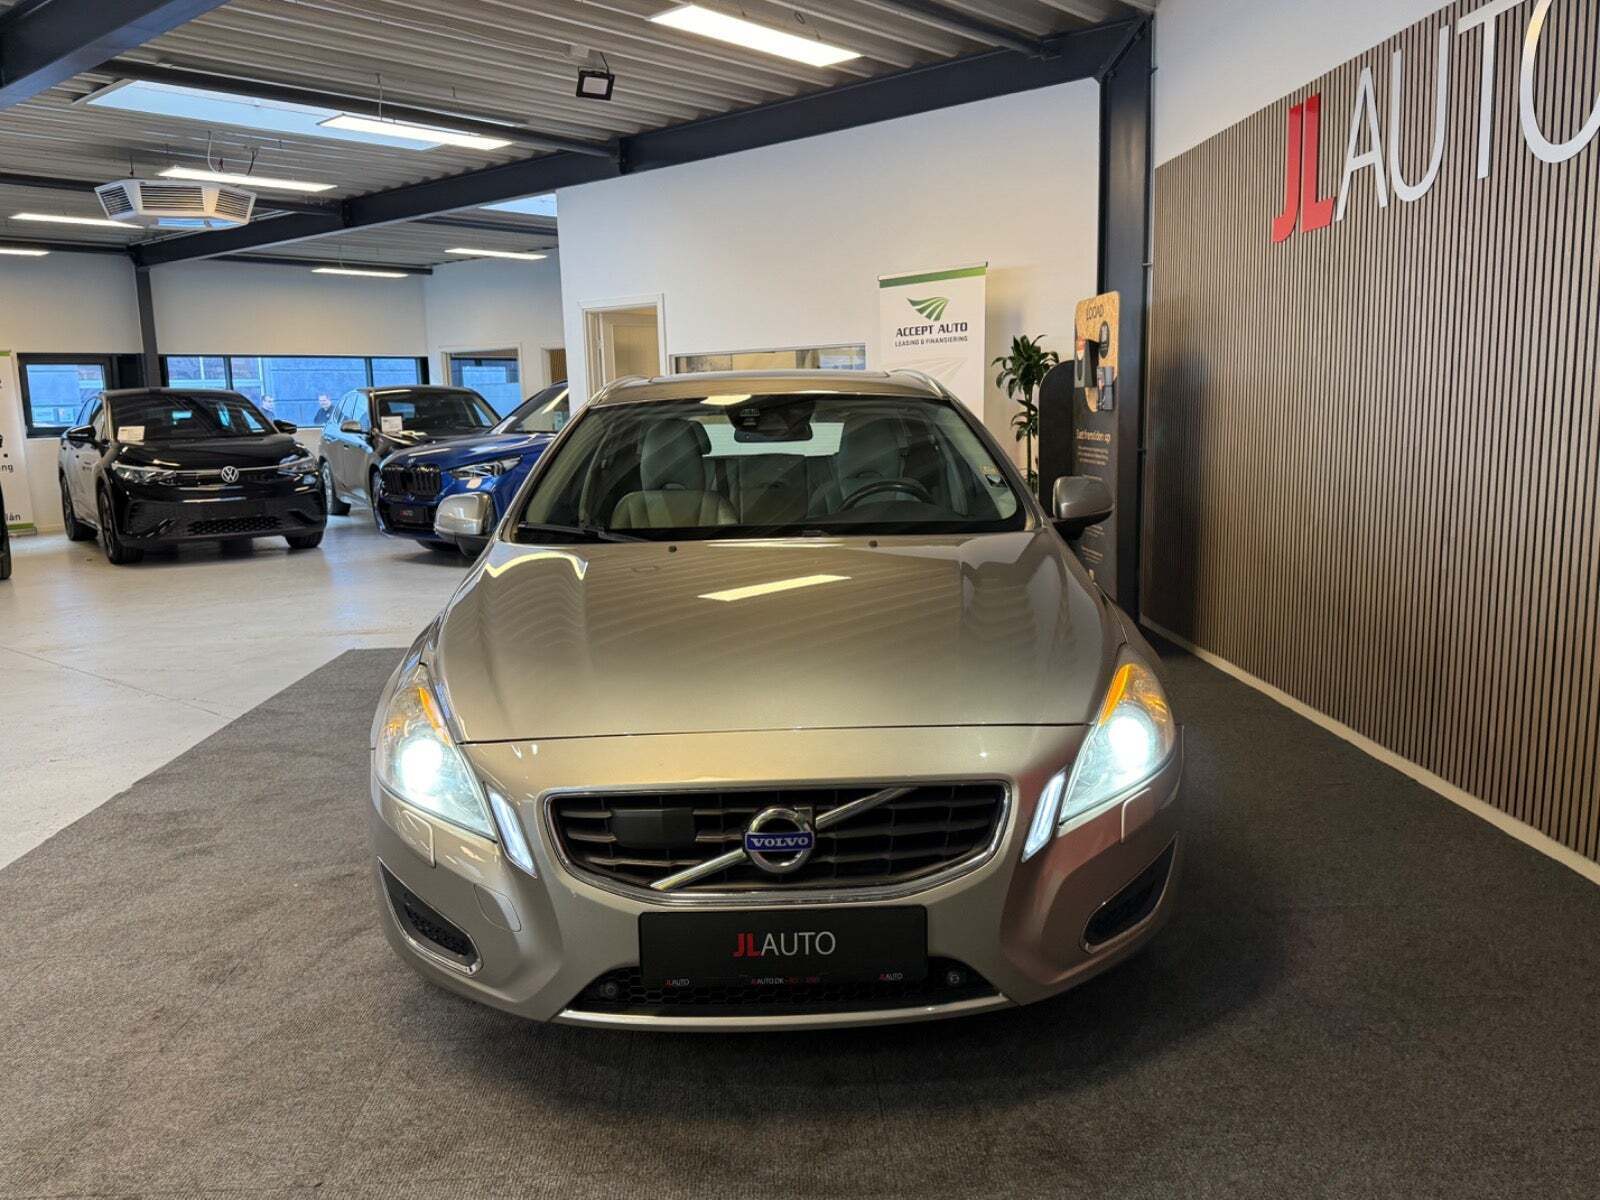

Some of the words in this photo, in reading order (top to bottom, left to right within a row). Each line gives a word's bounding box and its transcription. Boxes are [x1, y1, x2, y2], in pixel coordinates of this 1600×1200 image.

[896, 324, 935, 337] ACCEPT
[938, 322, 968, 334] AUTO
[895, 339, 920, 347] LEASING
[750, 837, 809, 848] VOLVO
[733, 931, 836, 957] JLAUTO
